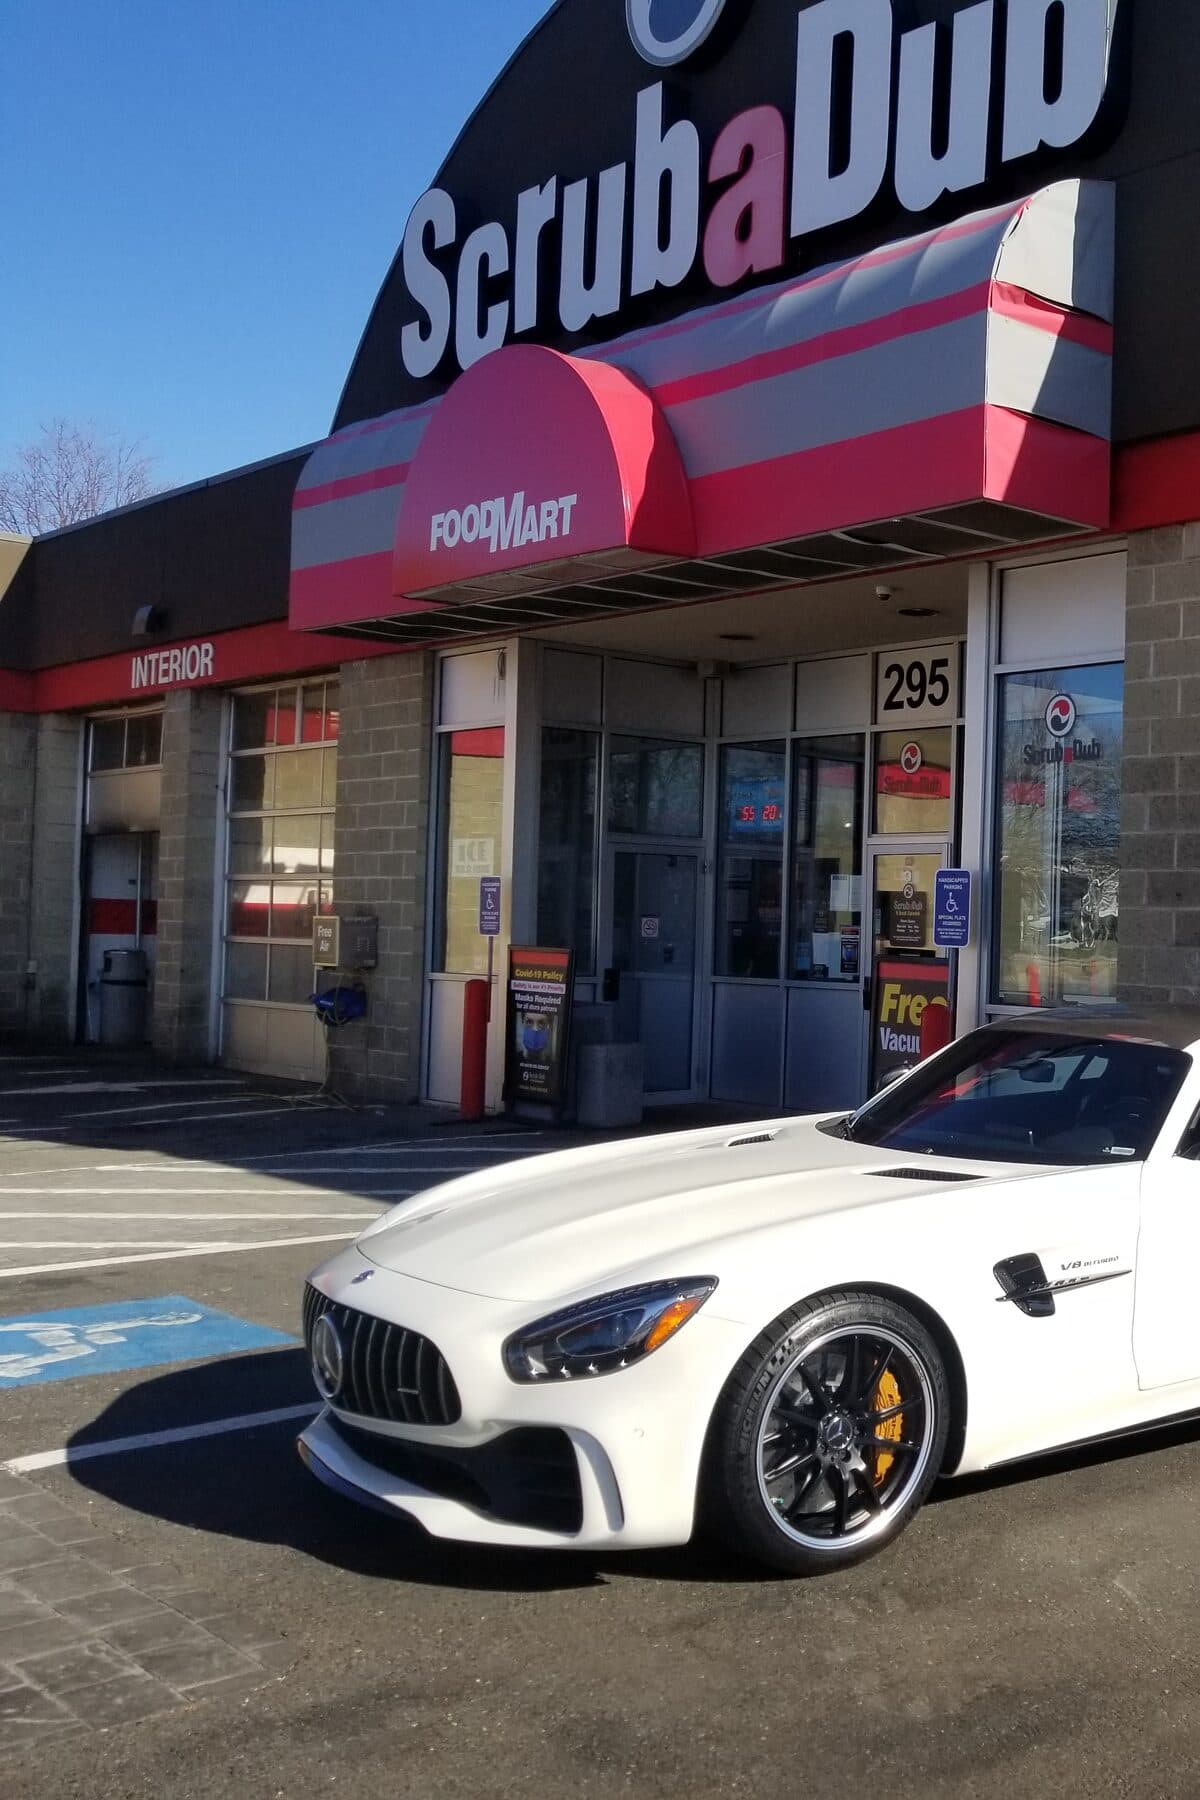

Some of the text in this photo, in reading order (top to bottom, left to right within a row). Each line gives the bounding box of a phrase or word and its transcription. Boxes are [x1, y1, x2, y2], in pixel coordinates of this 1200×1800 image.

[400, 0, 1110, 379] ScrubaDub
[430, 491, 577, 553] FOODMART
[131, 642, 213, 689] INTERIOR
[883, 658, 949, 710] 295
[515, 968, 564, 982] Covid-19 Policy
[880, 983, 948, 1026] Fre
